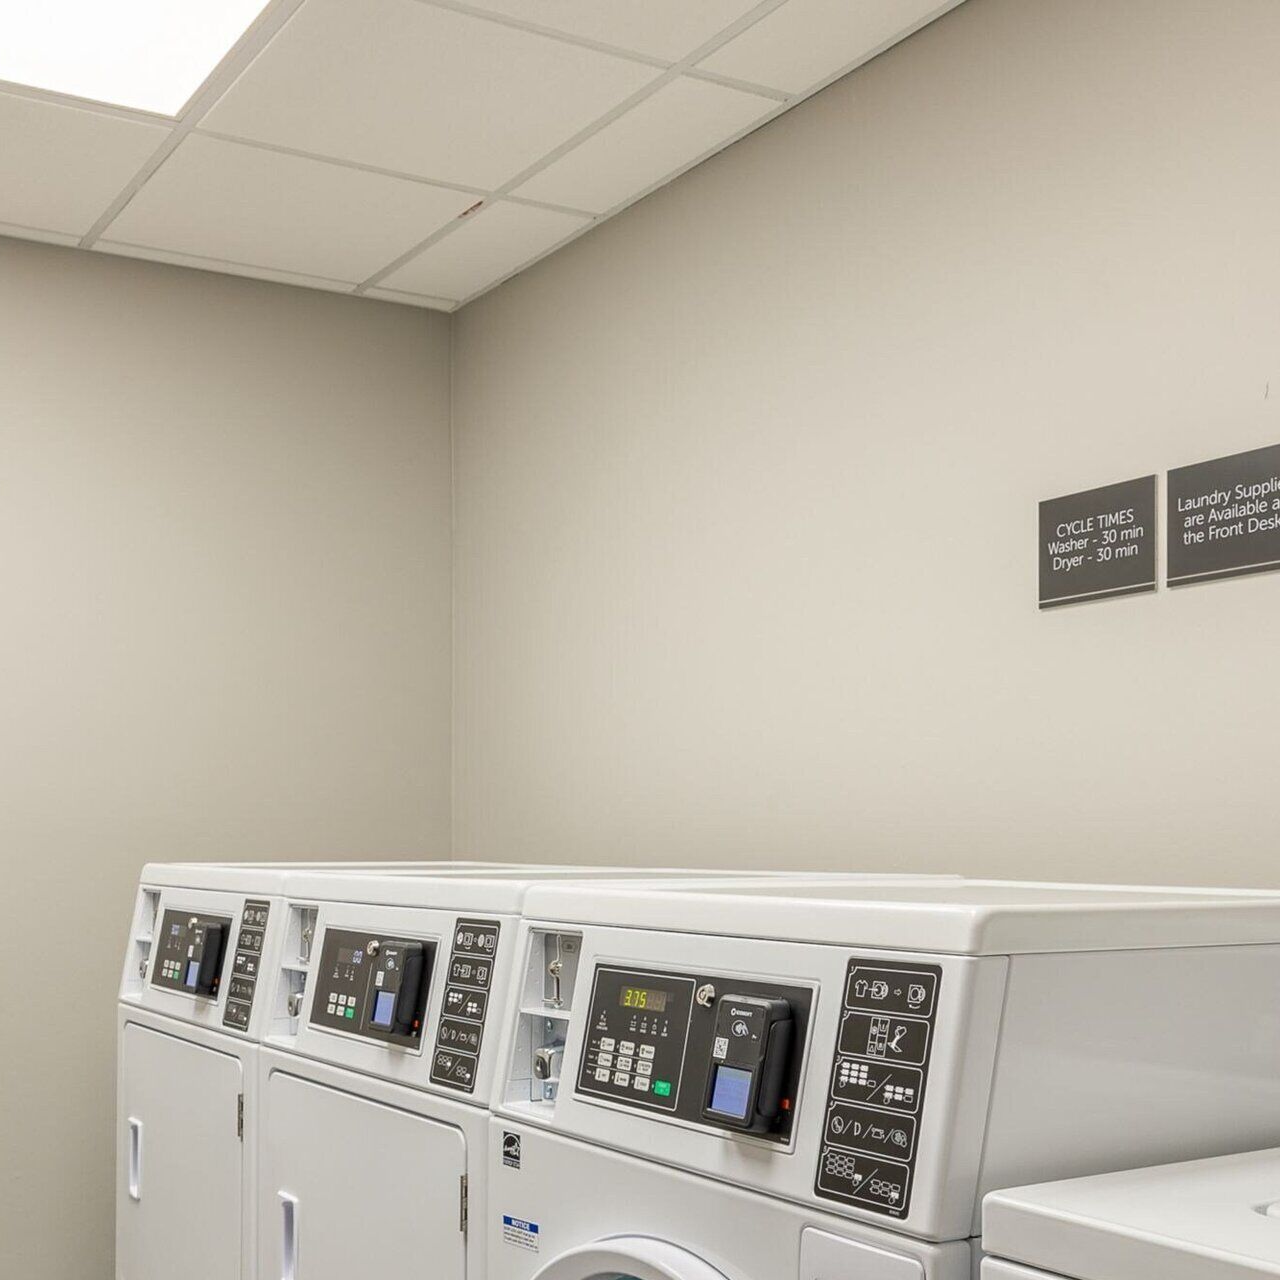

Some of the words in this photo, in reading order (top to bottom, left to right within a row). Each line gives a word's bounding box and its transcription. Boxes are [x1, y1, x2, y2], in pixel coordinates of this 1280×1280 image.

[1177, 490, 1231, 512] Laundry
[1184, 514, 1204, 528] are
[1208, 499, 1268, 523] Available
[1056, 517, 1094, 538] CYCLE
[1096, 508, 1134, 529] TIMES
[1183, 531, 1204, 545] the
[1209, 522, 1243, 540] Front
[1048, 538, 1089, 555] Washer
[1101, 529, 1117, 544] 30
[1121, 525, 1144, 541] min
[1053, 555, 1084, 572] Dryer
[1096, 547, 1112, 562] 30
[1115, 543, 1138, 559] min
